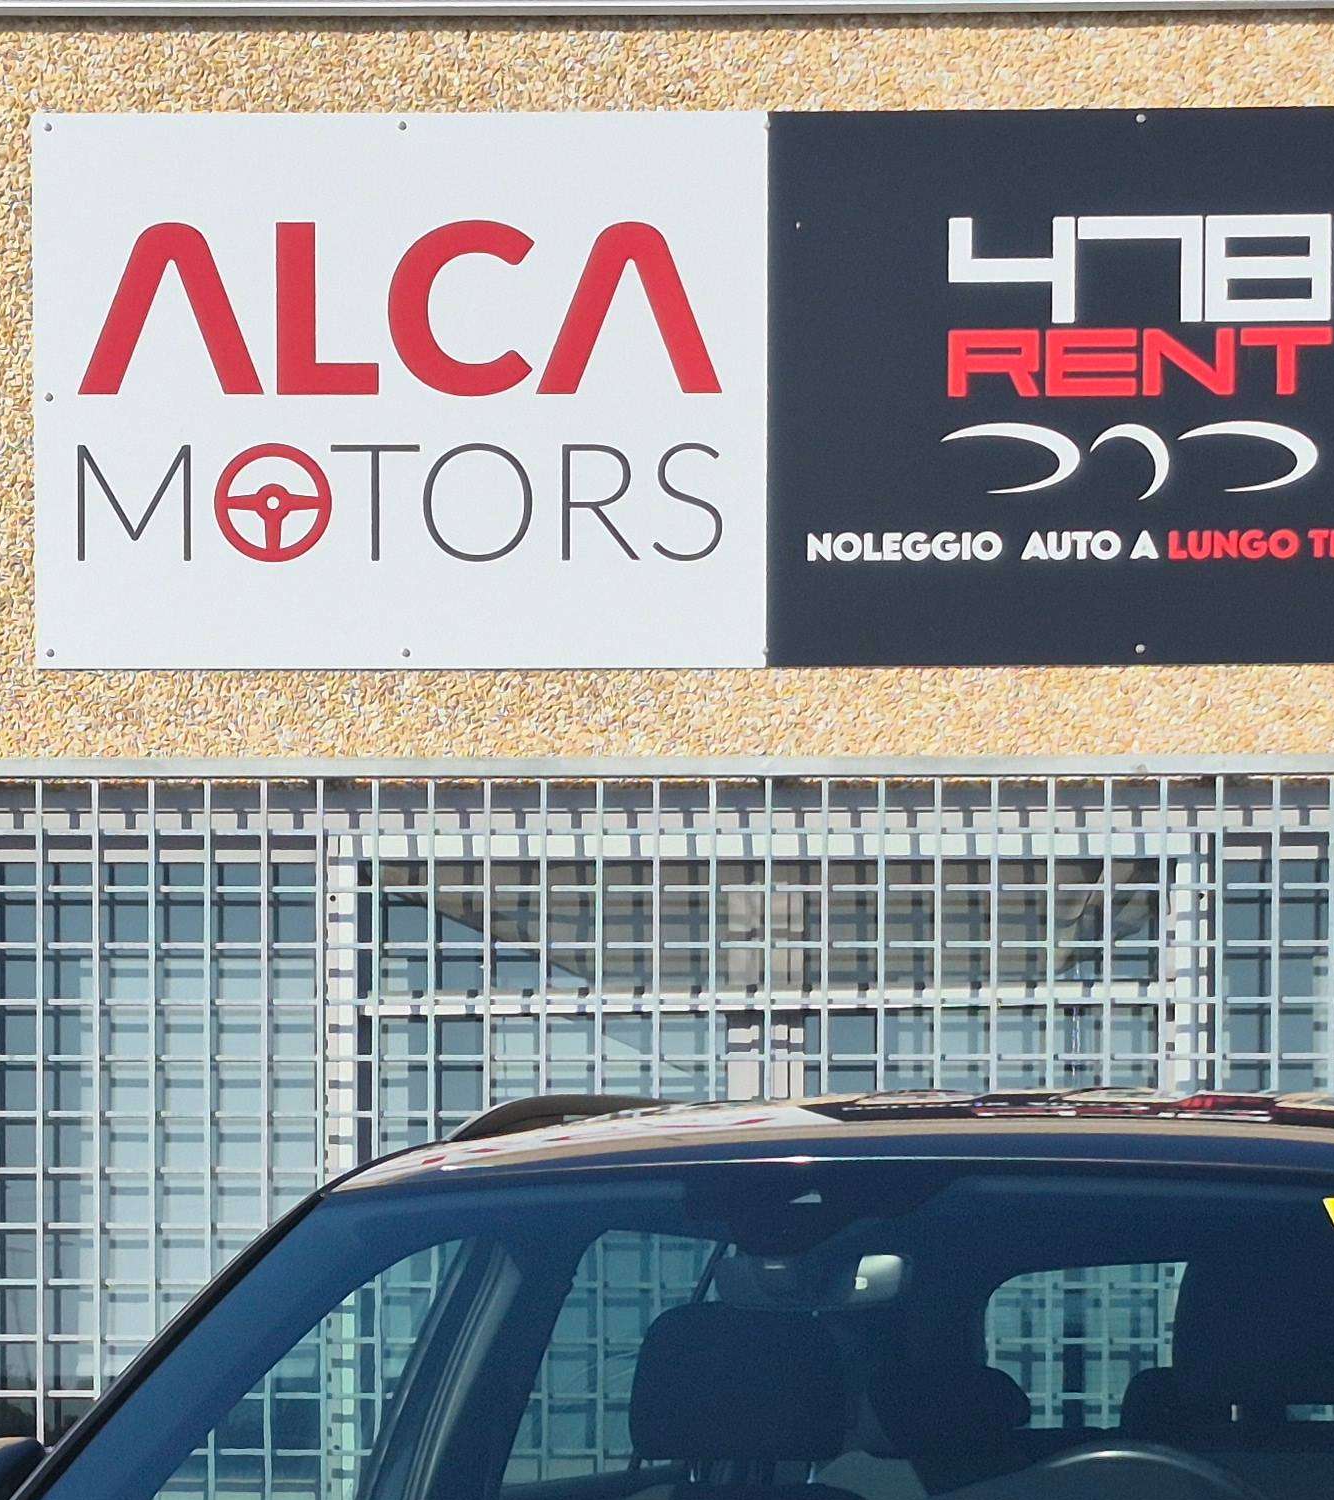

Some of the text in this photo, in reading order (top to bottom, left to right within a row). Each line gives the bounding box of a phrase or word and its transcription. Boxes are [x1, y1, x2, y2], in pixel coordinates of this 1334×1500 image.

[79, 219, 722, 398] ALCA
[948, 214, 1333, 323] 478
[947, 325, 1334, 399] RENT
[77, 442, 723, 563] MOTORS
[806, 530, 1003, 562] NOLEGGIO
[1020, 529, 1123, 561] AUTO
[1129, 529, 1160, 561] A
[1167, 528, 1301, 560] LUNGO
